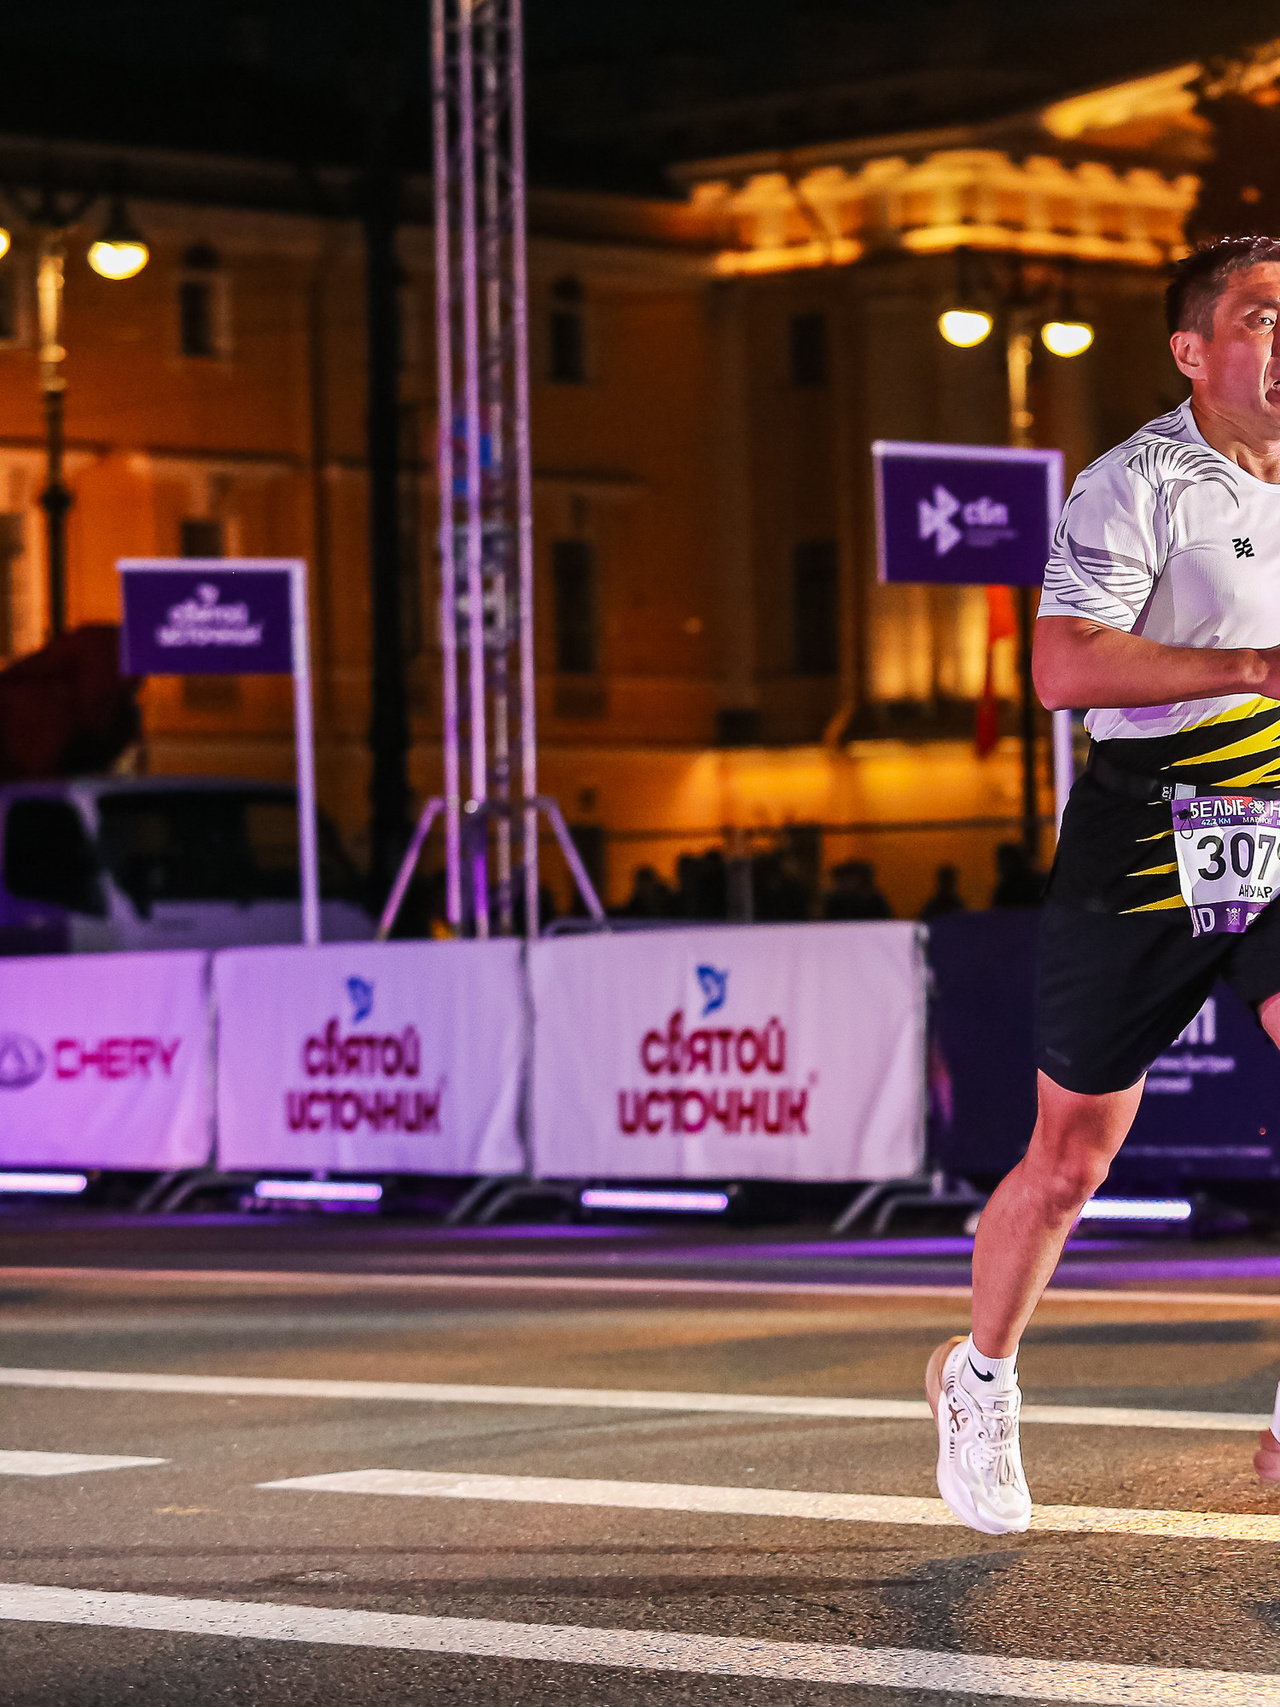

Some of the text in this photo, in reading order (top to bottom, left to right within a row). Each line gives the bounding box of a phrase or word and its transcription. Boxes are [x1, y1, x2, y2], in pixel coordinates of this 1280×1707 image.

[1190, 799, 1246, 819] БЕЛЫЕ
[1238, 884, 1273, 899] АНУАР
[54, 1037, 181, 1080] CHERY
